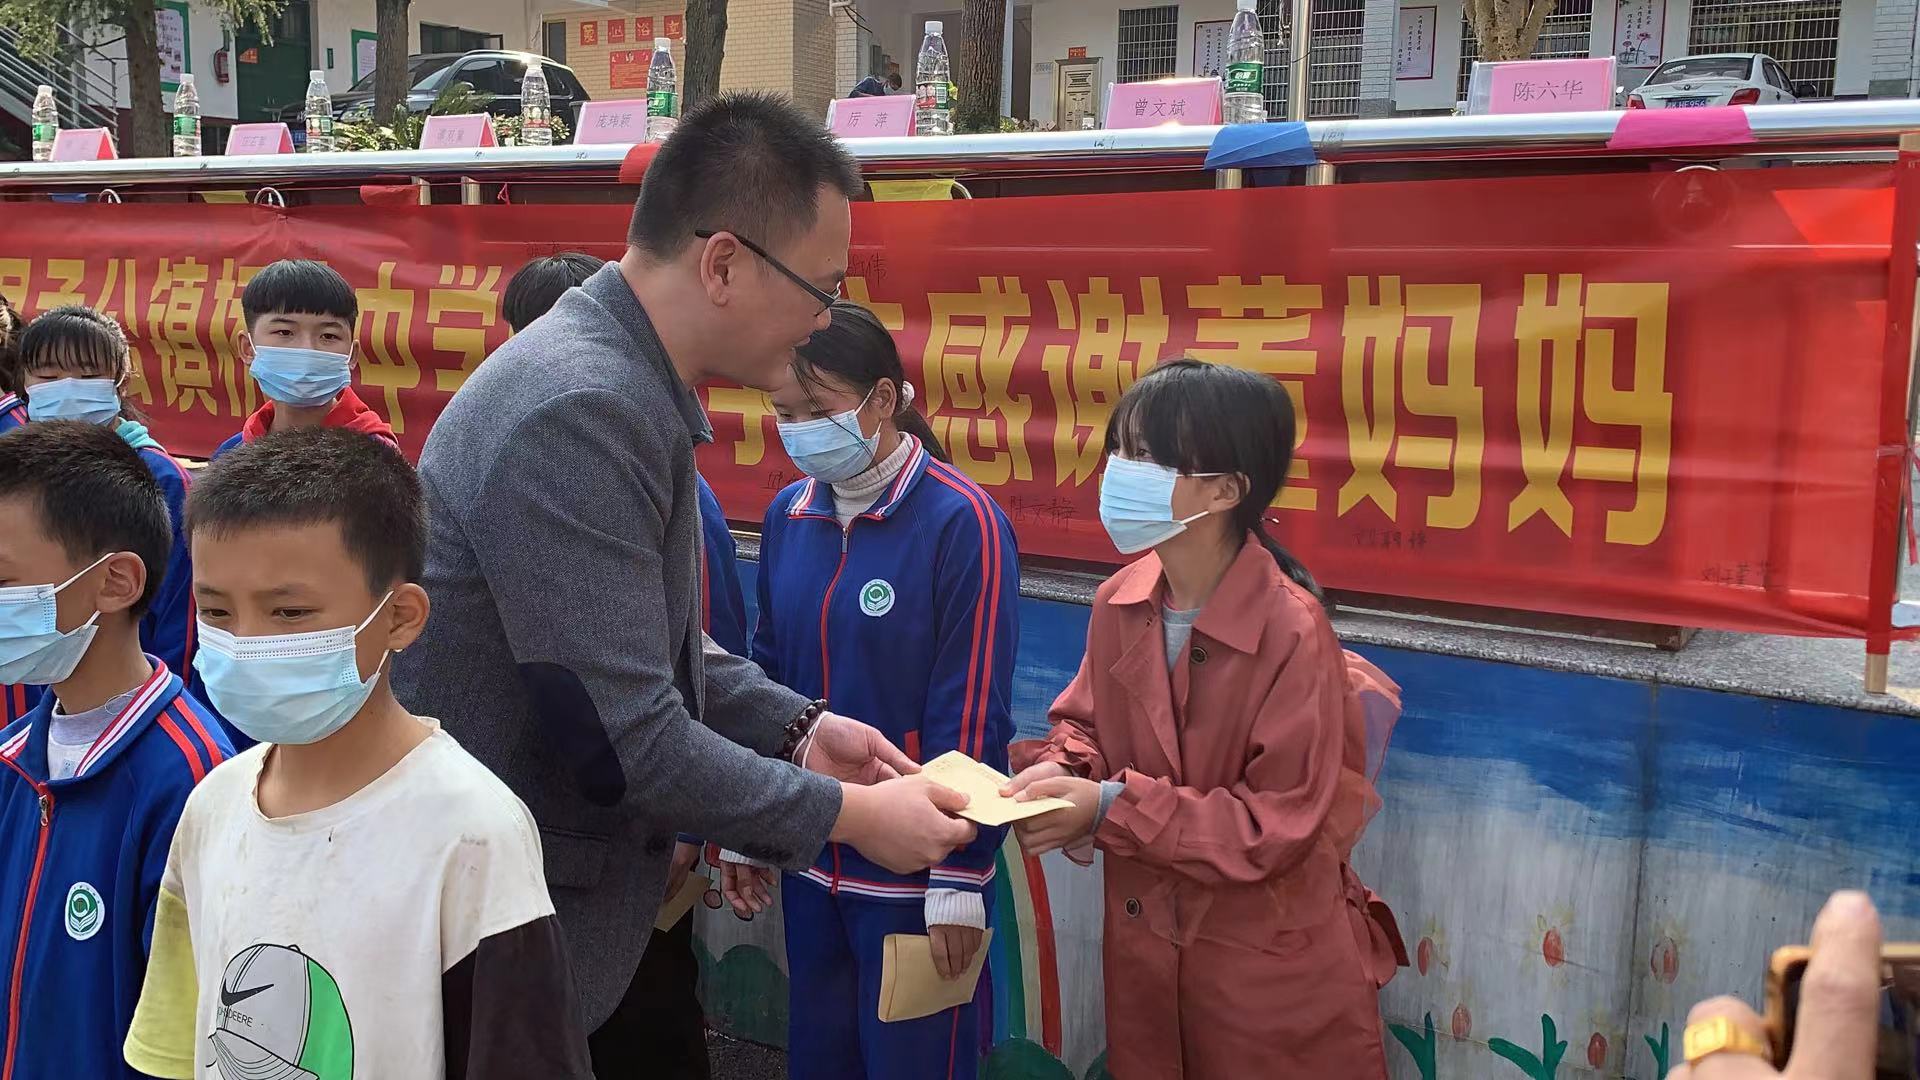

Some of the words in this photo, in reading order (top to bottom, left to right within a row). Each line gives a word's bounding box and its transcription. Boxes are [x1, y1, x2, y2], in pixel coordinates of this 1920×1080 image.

[1512, 79, 1583, 103] 陈六华
[1135, 98, 1186, 117] 曾文斌
